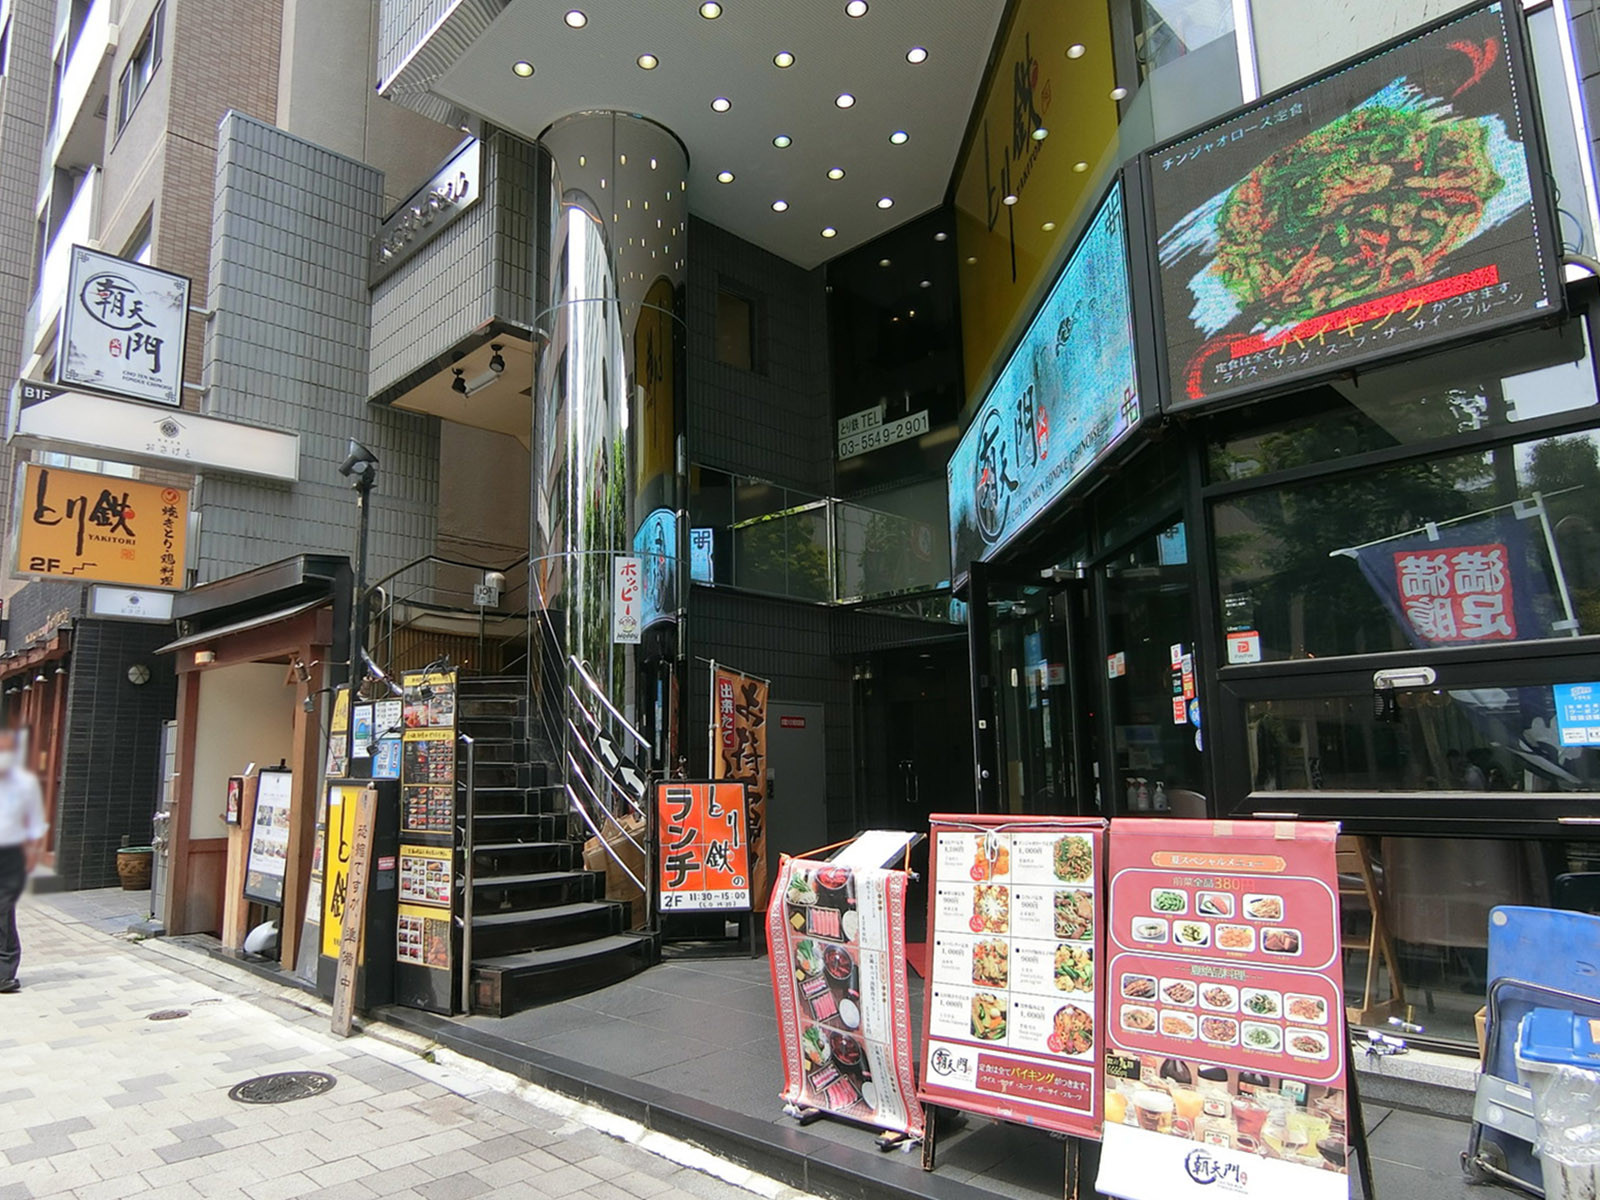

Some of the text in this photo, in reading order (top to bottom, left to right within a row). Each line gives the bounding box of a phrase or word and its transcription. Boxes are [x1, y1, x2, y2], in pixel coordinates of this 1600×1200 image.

[24, 387, 52, 401] B1F
[861, 411, 880, 428] TEL
[840, 415, 927, 456] 03-5549-2901
[88, 533, 136, 546] YAKITORI
[160, 505, 179, 586] 焼きとり・鶏料理
[29, 556, 61, 572] 2F
[620, 562, 639, 615] ホッピー
[720, 683, 733, 745] 出来たて
[665, 788, 702, 888] ランチ
[664, 895, 683, 907] 2F
[1010, 1067, 1055, 1084] バイキング
